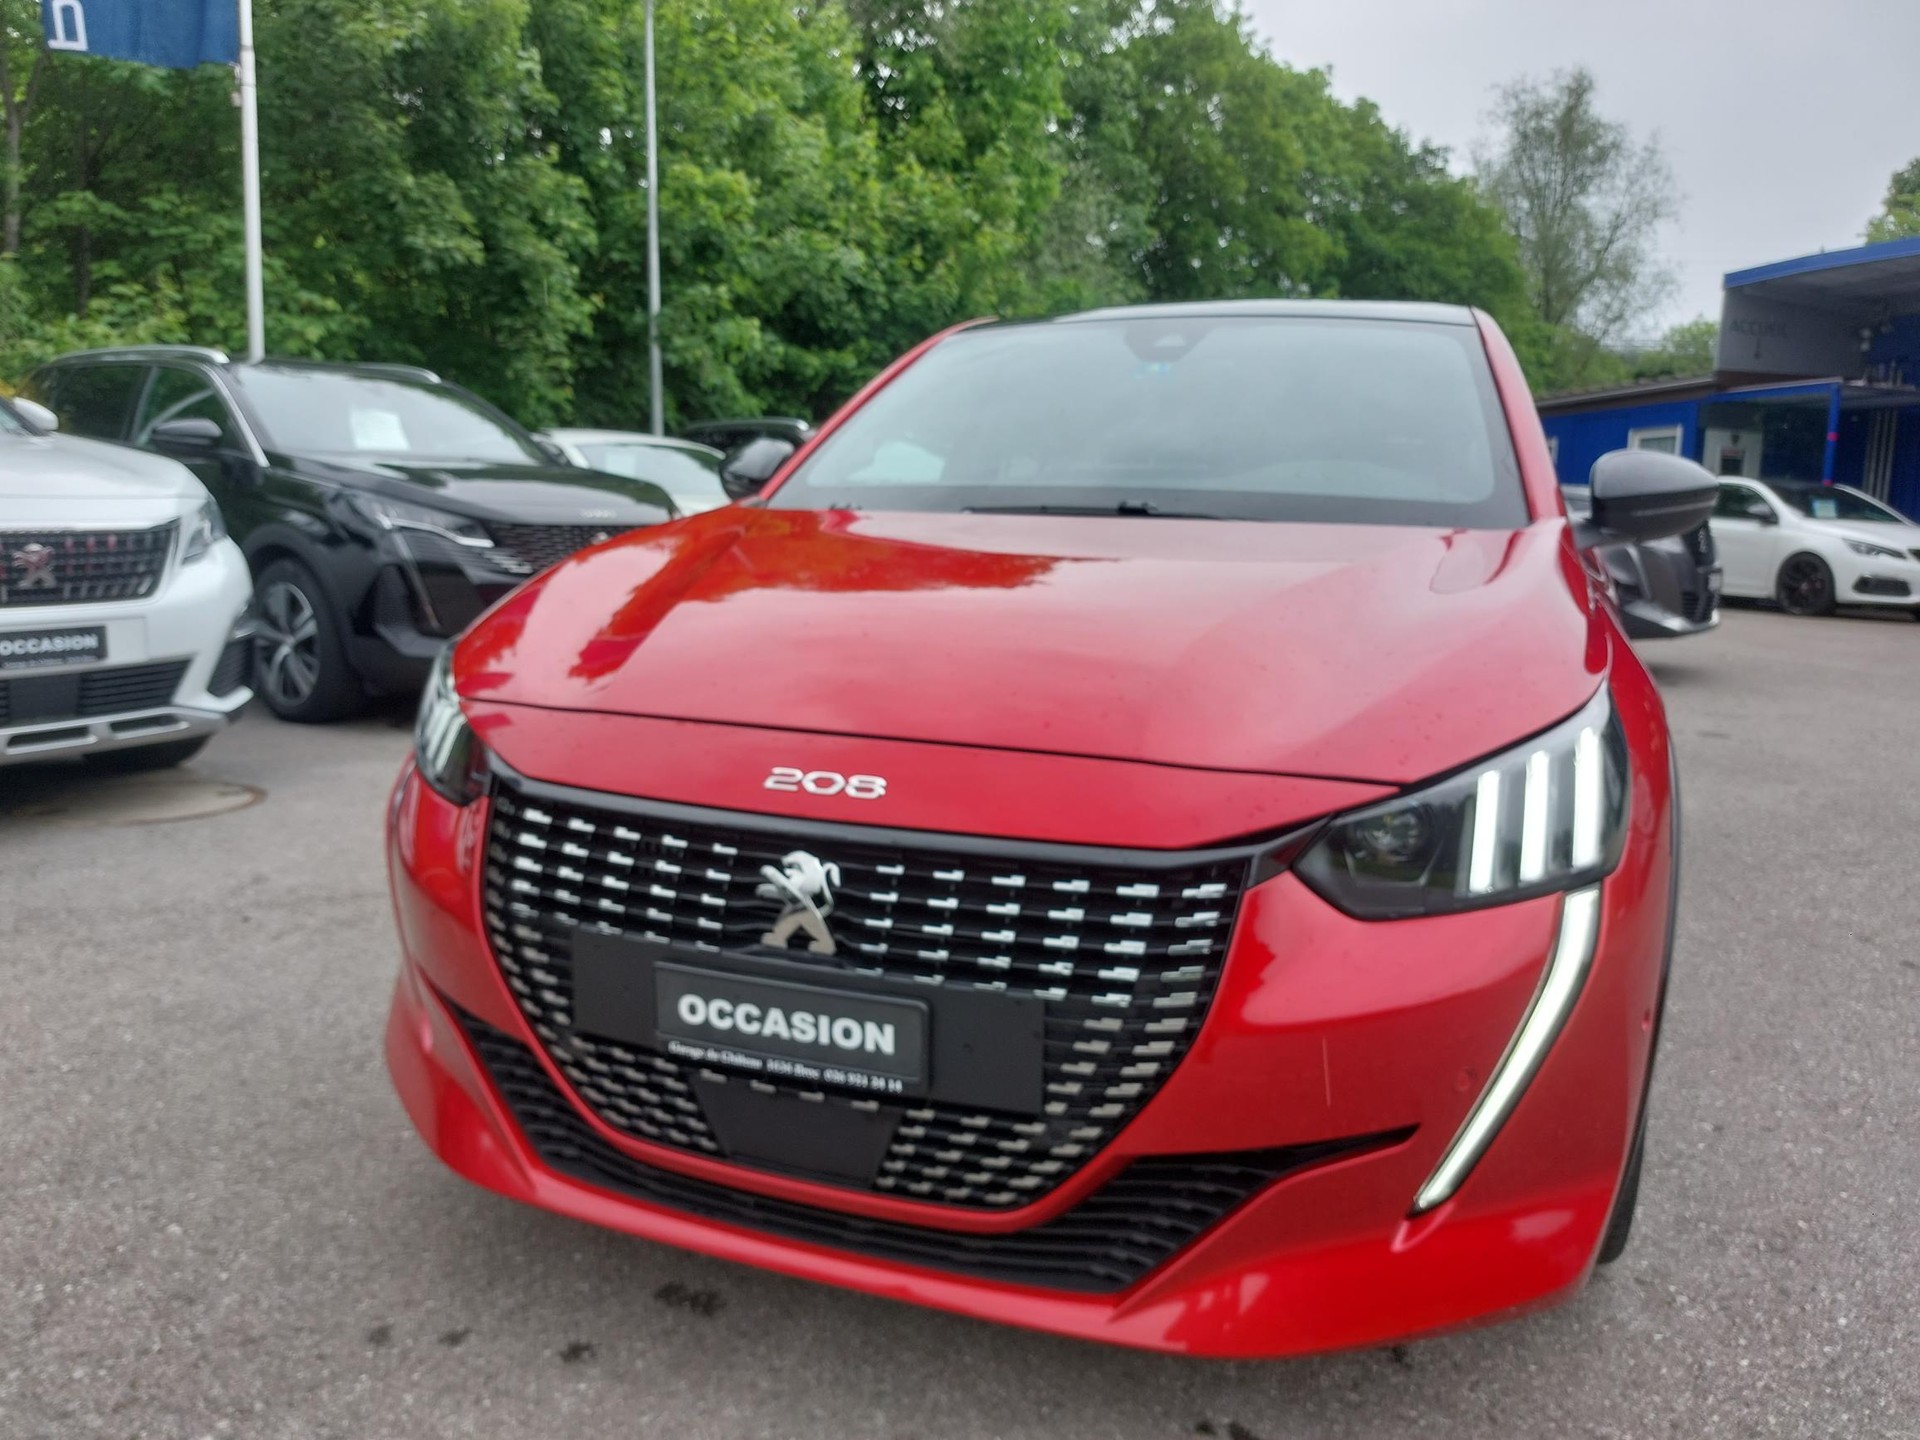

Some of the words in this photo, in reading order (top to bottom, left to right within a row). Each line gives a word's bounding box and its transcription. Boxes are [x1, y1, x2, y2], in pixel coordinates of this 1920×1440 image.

[0, 633, 98, 656] OCCASION
[763, 766, 887, 799] 208
[677, 993, 895, 1055] OCCASION
